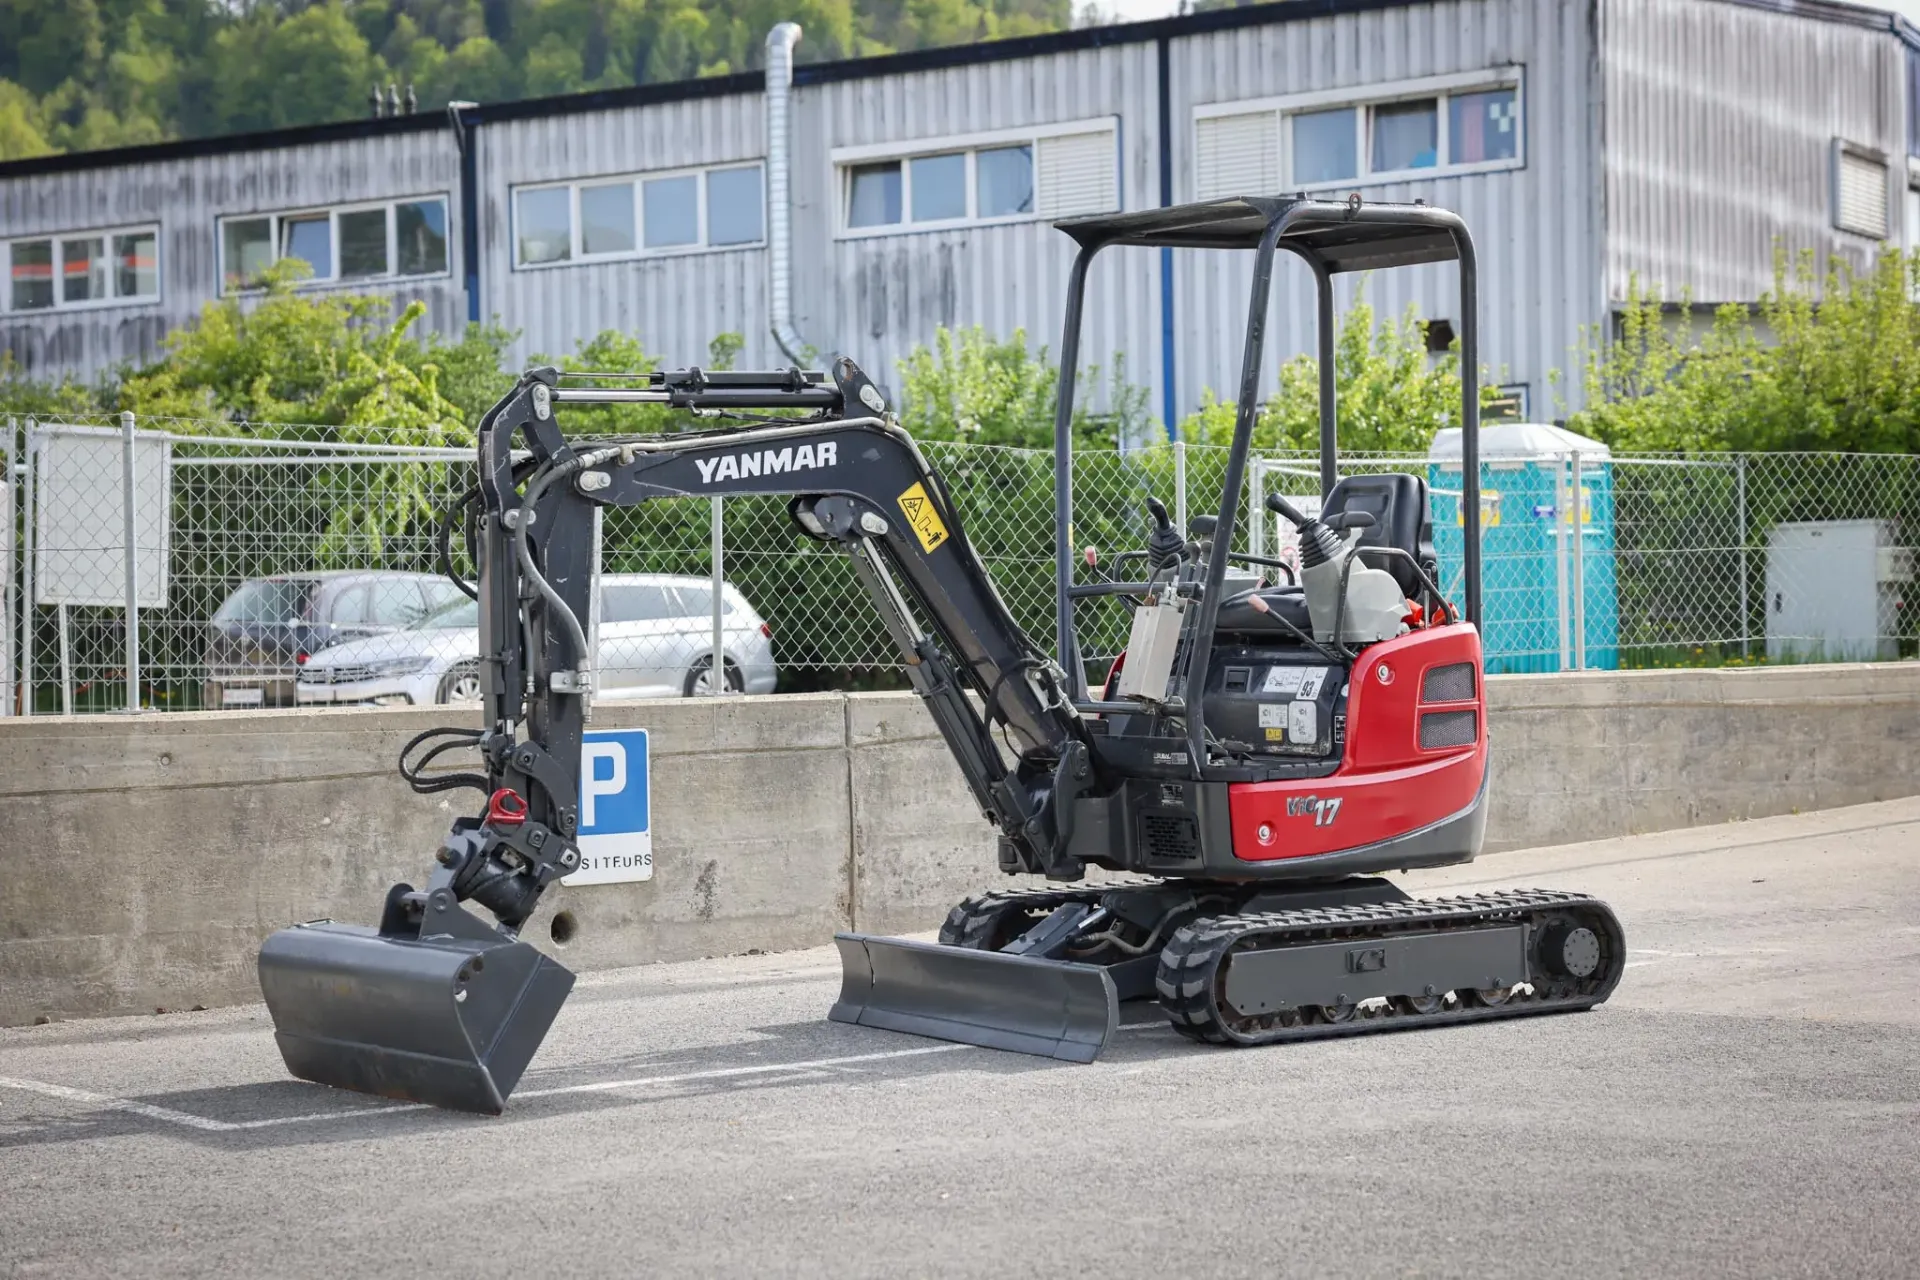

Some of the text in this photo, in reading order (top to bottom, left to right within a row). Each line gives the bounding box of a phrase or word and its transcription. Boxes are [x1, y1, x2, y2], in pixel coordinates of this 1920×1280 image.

[694, 441, 838, 484] YANMAR
[1300, 680, 1316, 697] 93
[581, 741, 627, 827] P
[581, 853, 652, 870] SITEURS
